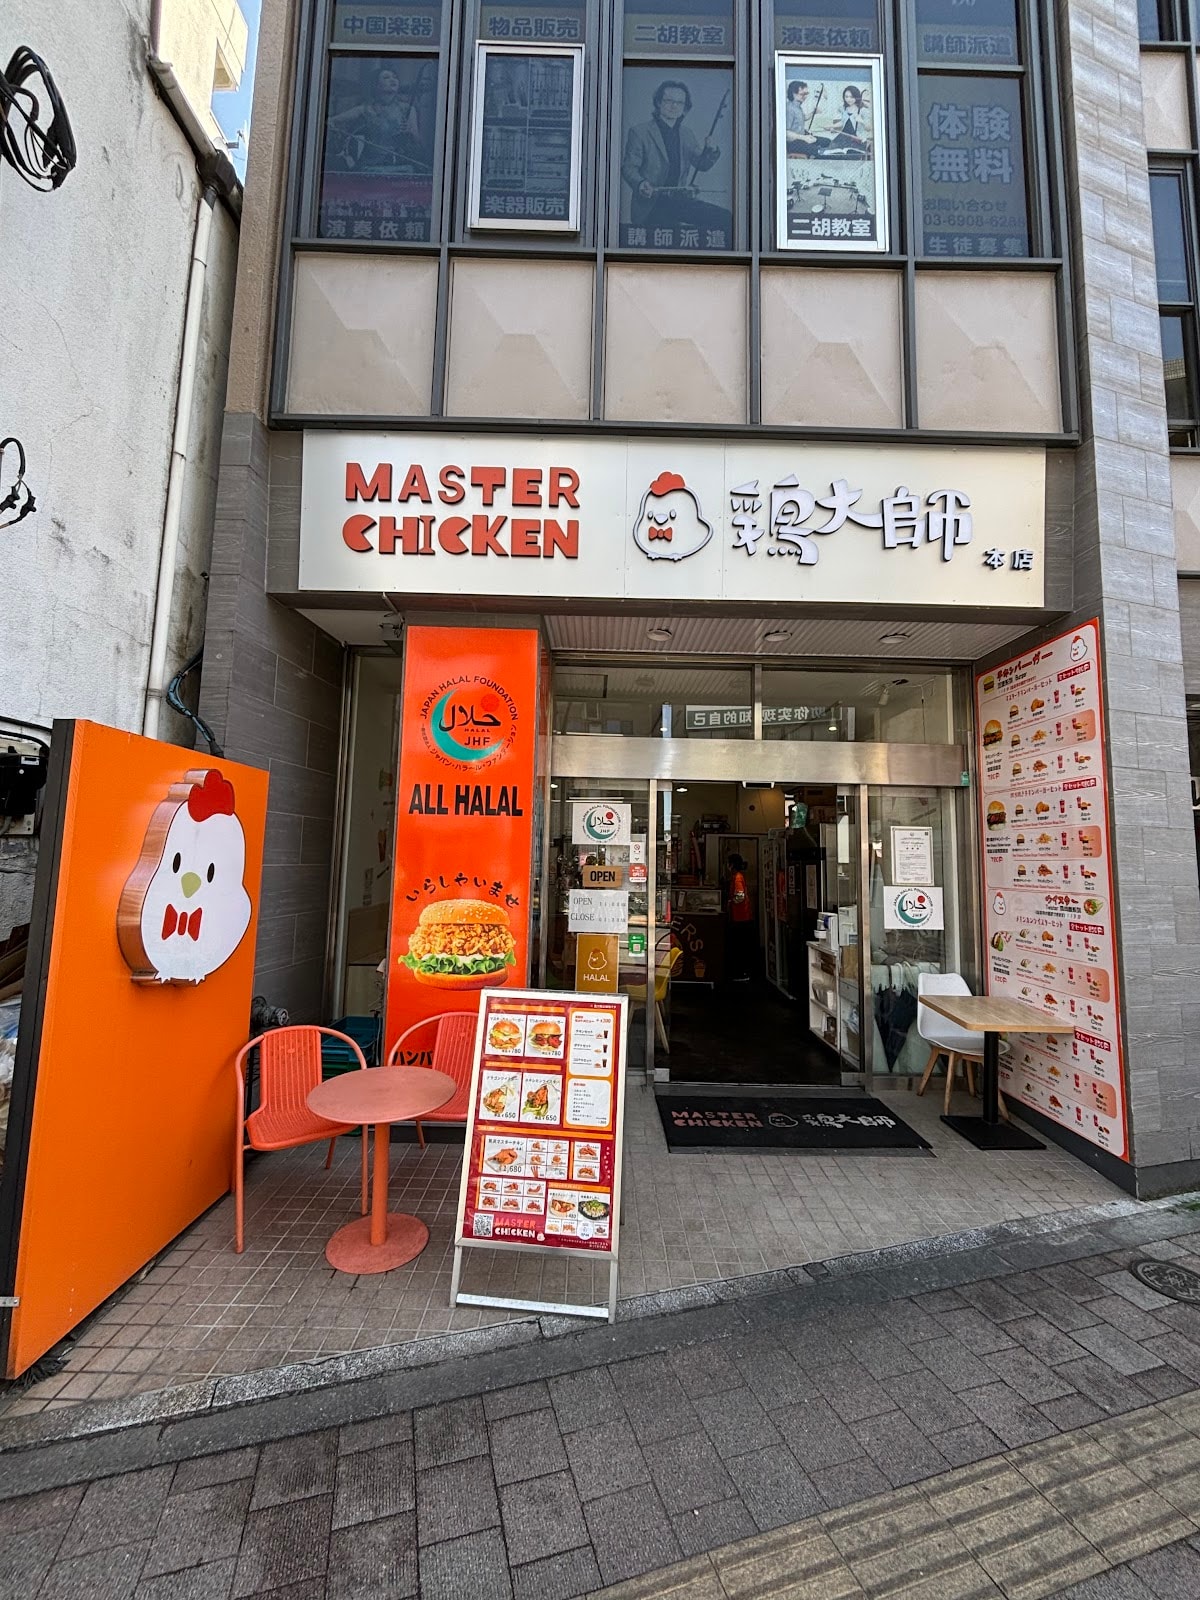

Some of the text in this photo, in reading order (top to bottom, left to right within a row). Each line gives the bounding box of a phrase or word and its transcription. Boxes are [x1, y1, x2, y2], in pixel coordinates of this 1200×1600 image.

[343, 15, 433, 38] 中国楽器
[489, 16, 579, 39] 物品販売
[634, 25, 724, 46] 二胡教室
[781, 26, 872, 48] 演奏依頼
[928, 103, 1012, 142] 体験
[929, 146, 1013, 184] 無料
[485, 196, 566, 217] 楽器販売
[327, 220, 425, 240] 演奏依頼
[627, 228, 727, 248] 講師派遣
[791, 218, 871, 238] 二胡教室
[928, 236, 1024, 256] 生徒募集
[345, 462, 581, 508] MASTER
[342, 513, 580, 559] CHICKEN
[984, 547, 1034, 571] 本店
[420, 675, 519, 721] JAPAN HALAL FOUNDATION
[438, 704, 502, 732] حلال
[464, 736, 491, 746] JHF
[408, 783, 523, 817] ALL HALAL
[590, 870, 616, 882] OPEN
[573, 897, 593, 906] OPEN
[570, 913, 595, 921] CLOSE
[583, 974, 611, 982] HALAL
[671, 1111, 758, 1120] MASTER
[673, 1119, 764, 1128] CHICKEN
[494, 1217, 536, 1229] MASTER
[494, 1227, 536, 1238] CHICKEN
